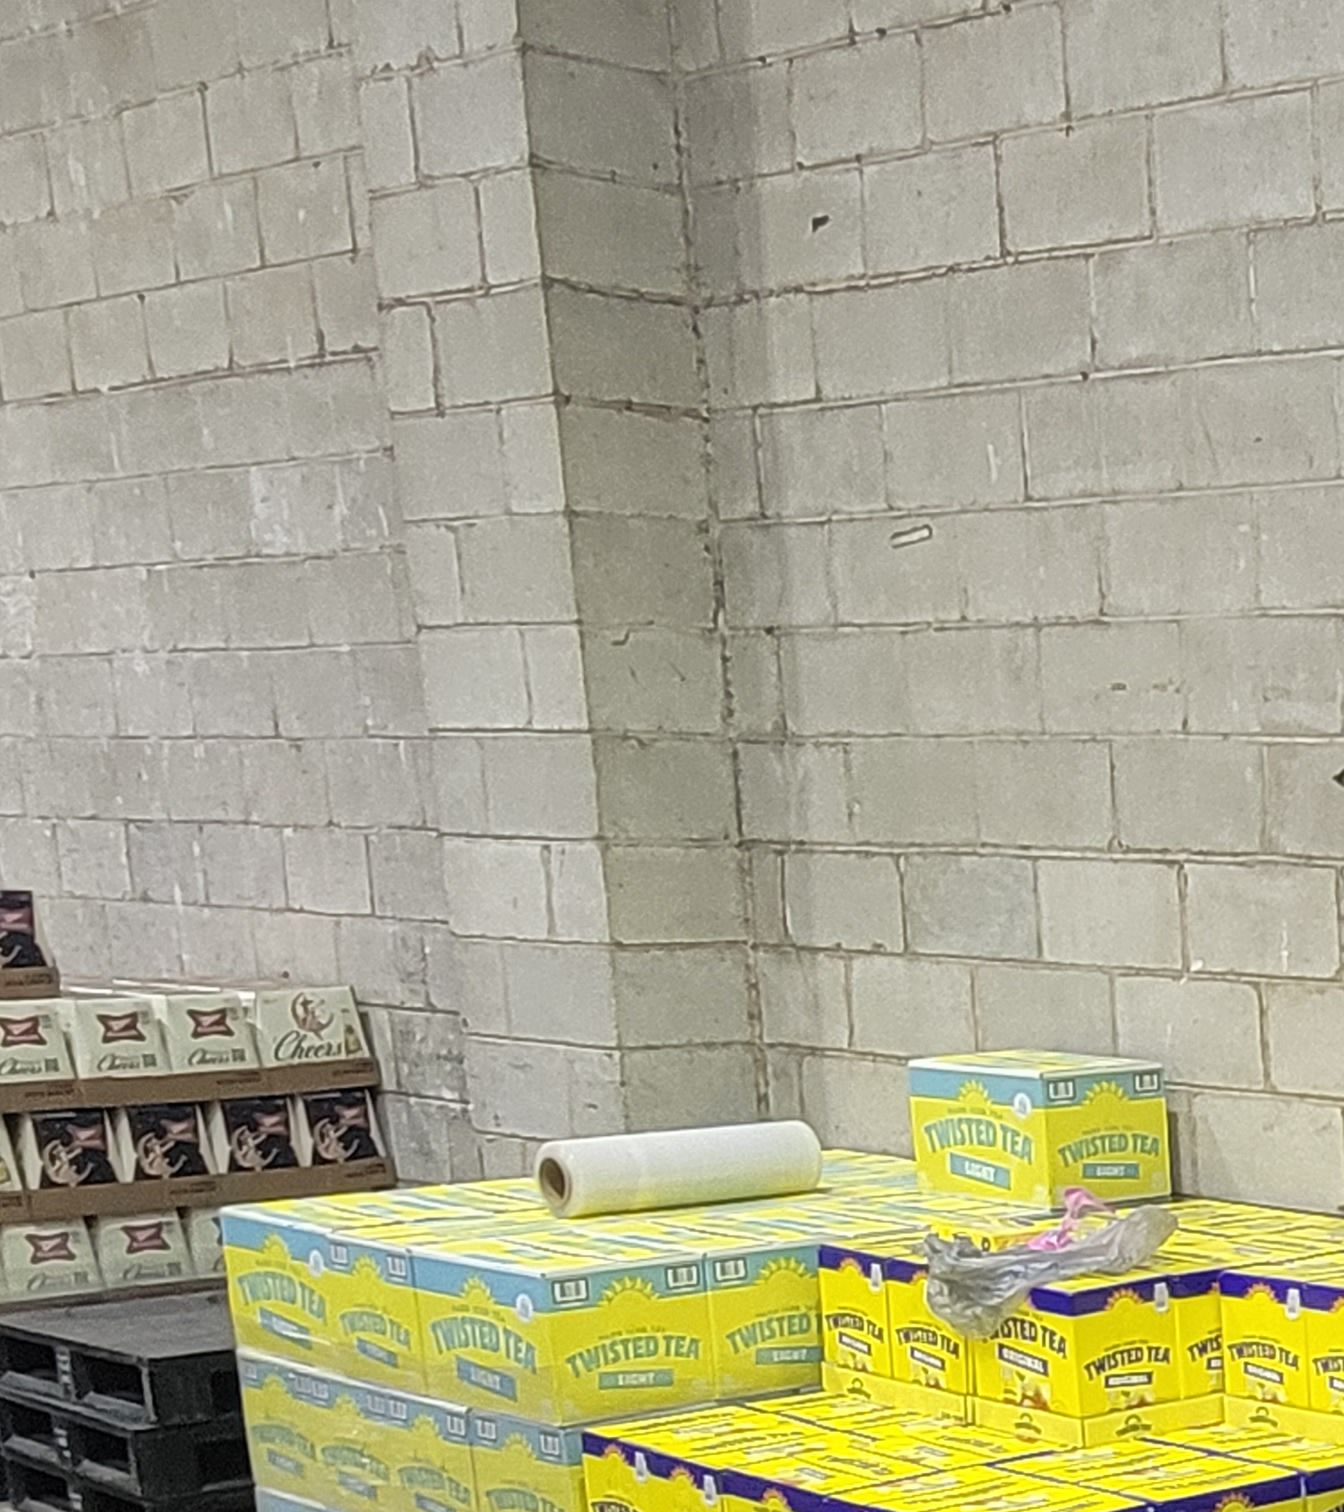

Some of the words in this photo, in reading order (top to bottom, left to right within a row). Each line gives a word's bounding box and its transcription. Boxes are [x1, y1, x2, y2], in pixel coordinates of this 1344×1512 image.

[923, 1117, 997, 1153] TWISTED
[999, 1122, 1034, 1166] TEA
[1057, 1133, 1129, 1168] TWISTED
[1131, 1132, 1161, 1157] TEA
[430, 1315, 500, 1356] TWISTED
[502, 1326, 537, 1375] TEA
[725, 1311, 812, 1355] TWISTED
[982, 1317, 1038, 1343] ISTED
[1041, 1325, 1067, 1359] TEA
[565, 1334, 659, 1379] TWISTED
[662, 1334, 701, 1360] TEA
[1083, 1347, 1144, 1381] TWISTED
[1147, 1347, 1171, 1364] TEA
[1278, 1346, 1299, 1371] TEA
